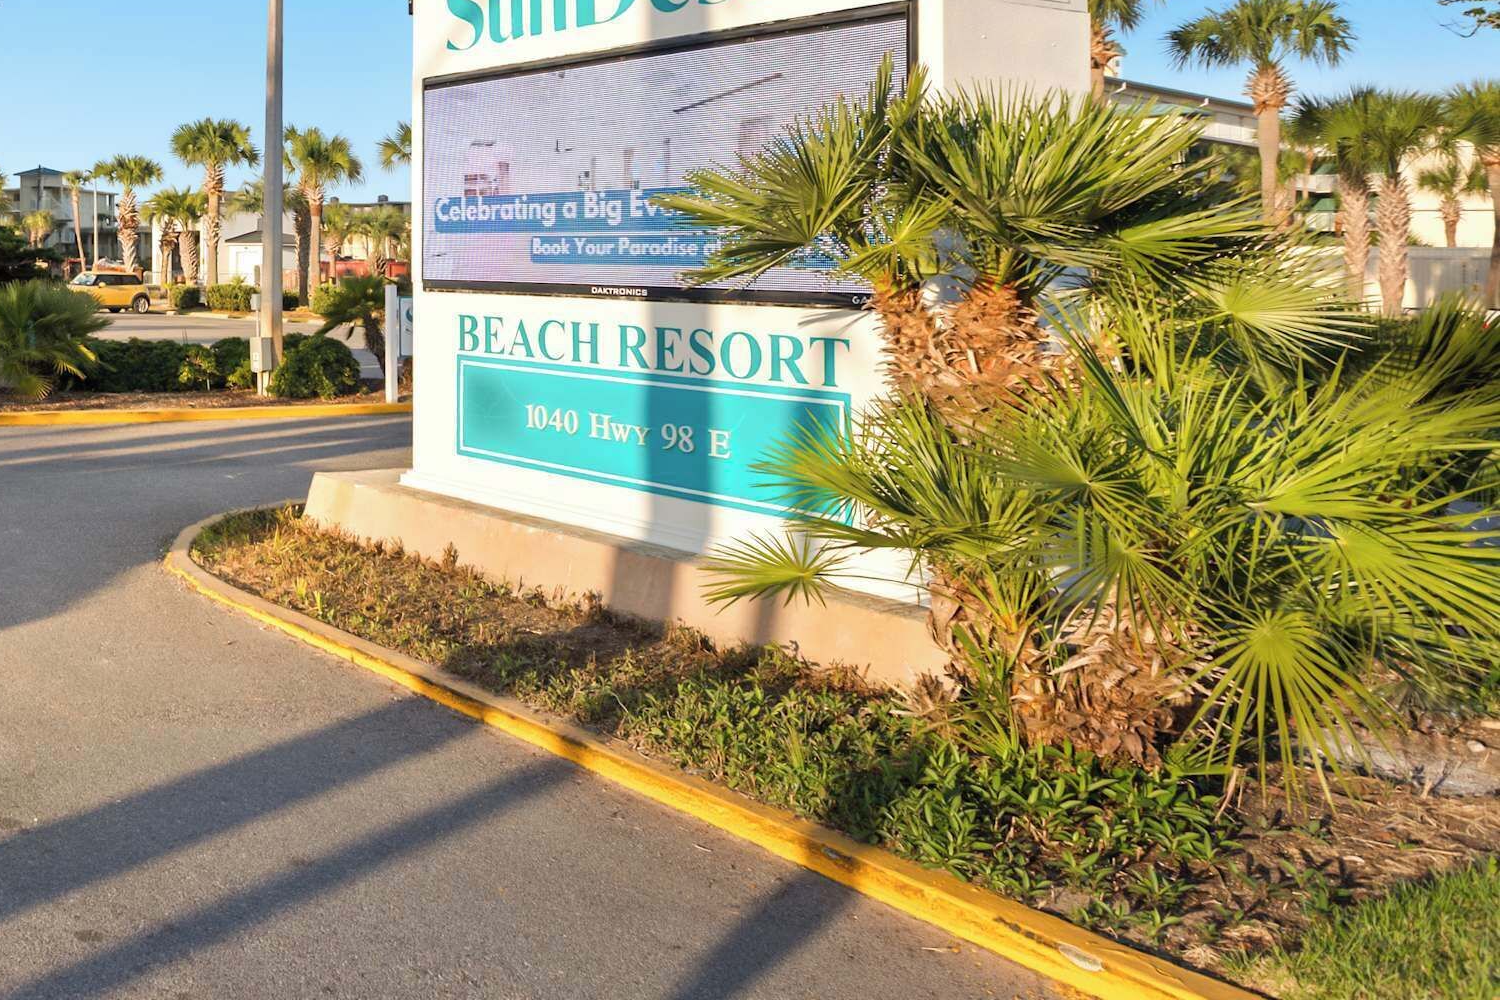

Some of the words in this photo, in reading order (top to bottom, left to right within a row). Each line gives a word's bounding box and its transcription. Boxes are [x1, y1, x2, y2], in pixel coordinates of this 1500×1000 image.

[436, 195, 556, 227] Celebrating
[562, 202, 577, 219] a
[584, 191, 622, 226] Big
[532, 237, 570, 255] Book
[574, 238, 614, 255] Your
[618, 238, 697, 256] Paradise
[591, 286, 648, 297] DAKTRONICS
[457, 314, 601, 365] BEACH
[618, 324, 851, 387] RESORT
[525, 404, 579, 435] 1040
[660, 423, 695, 453] 98
[707, 429, 732, 460] E
